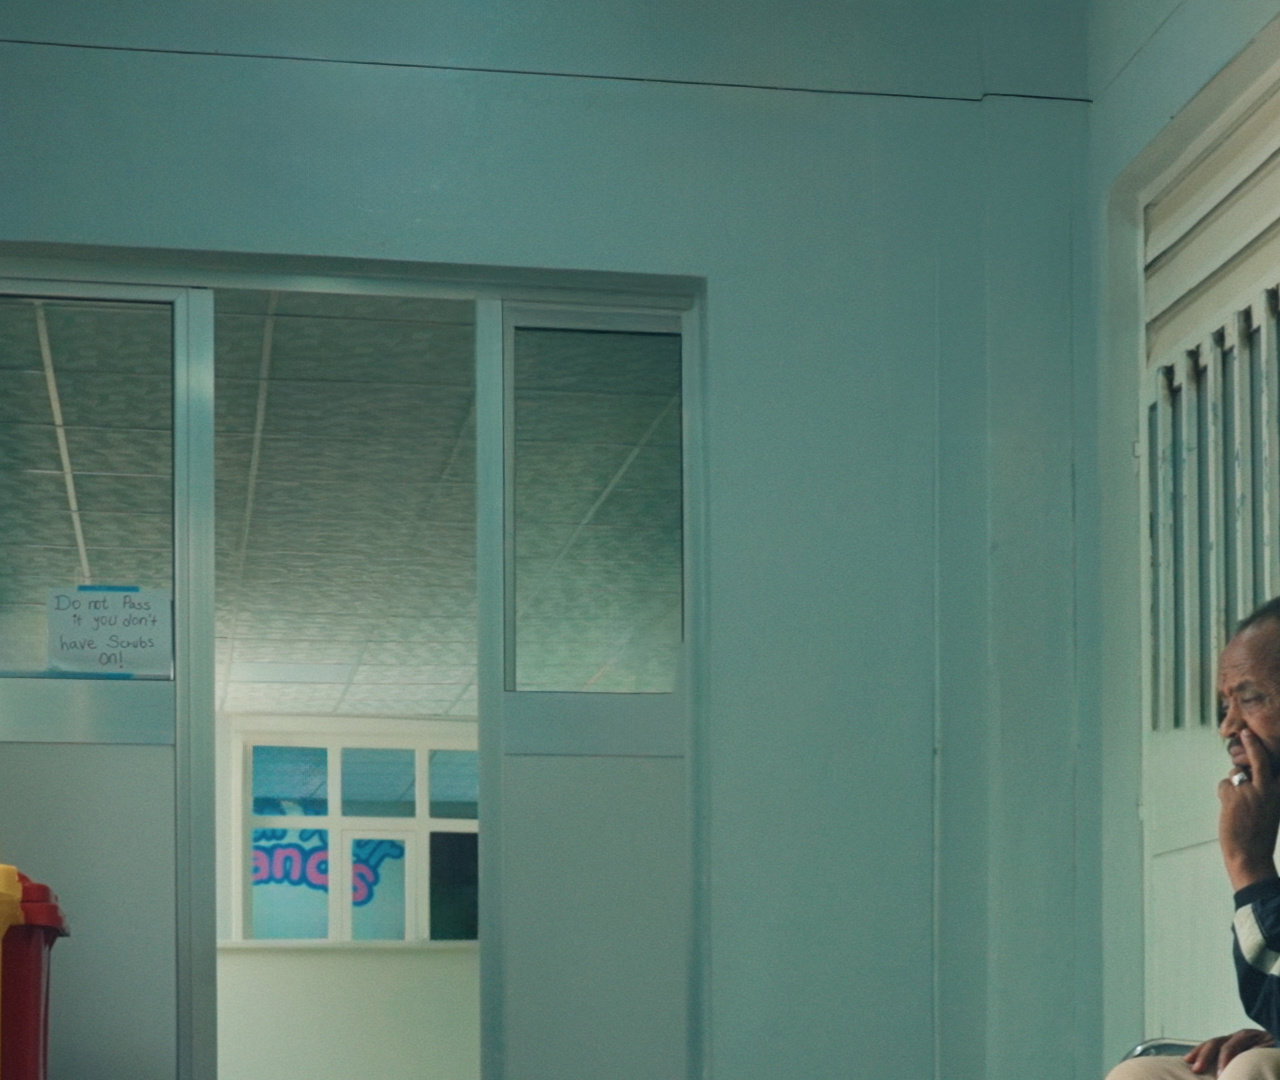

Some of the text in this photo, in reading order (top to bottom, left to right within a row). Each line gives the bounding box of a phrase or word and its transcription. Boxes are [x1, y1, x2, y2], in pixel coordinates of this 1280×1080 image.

[54, 594, 151, 611] Do not Pass
[92, 615, 118, 631] you
[122, 613, 158, 628] don't
[59, 635, 97, 650] have
